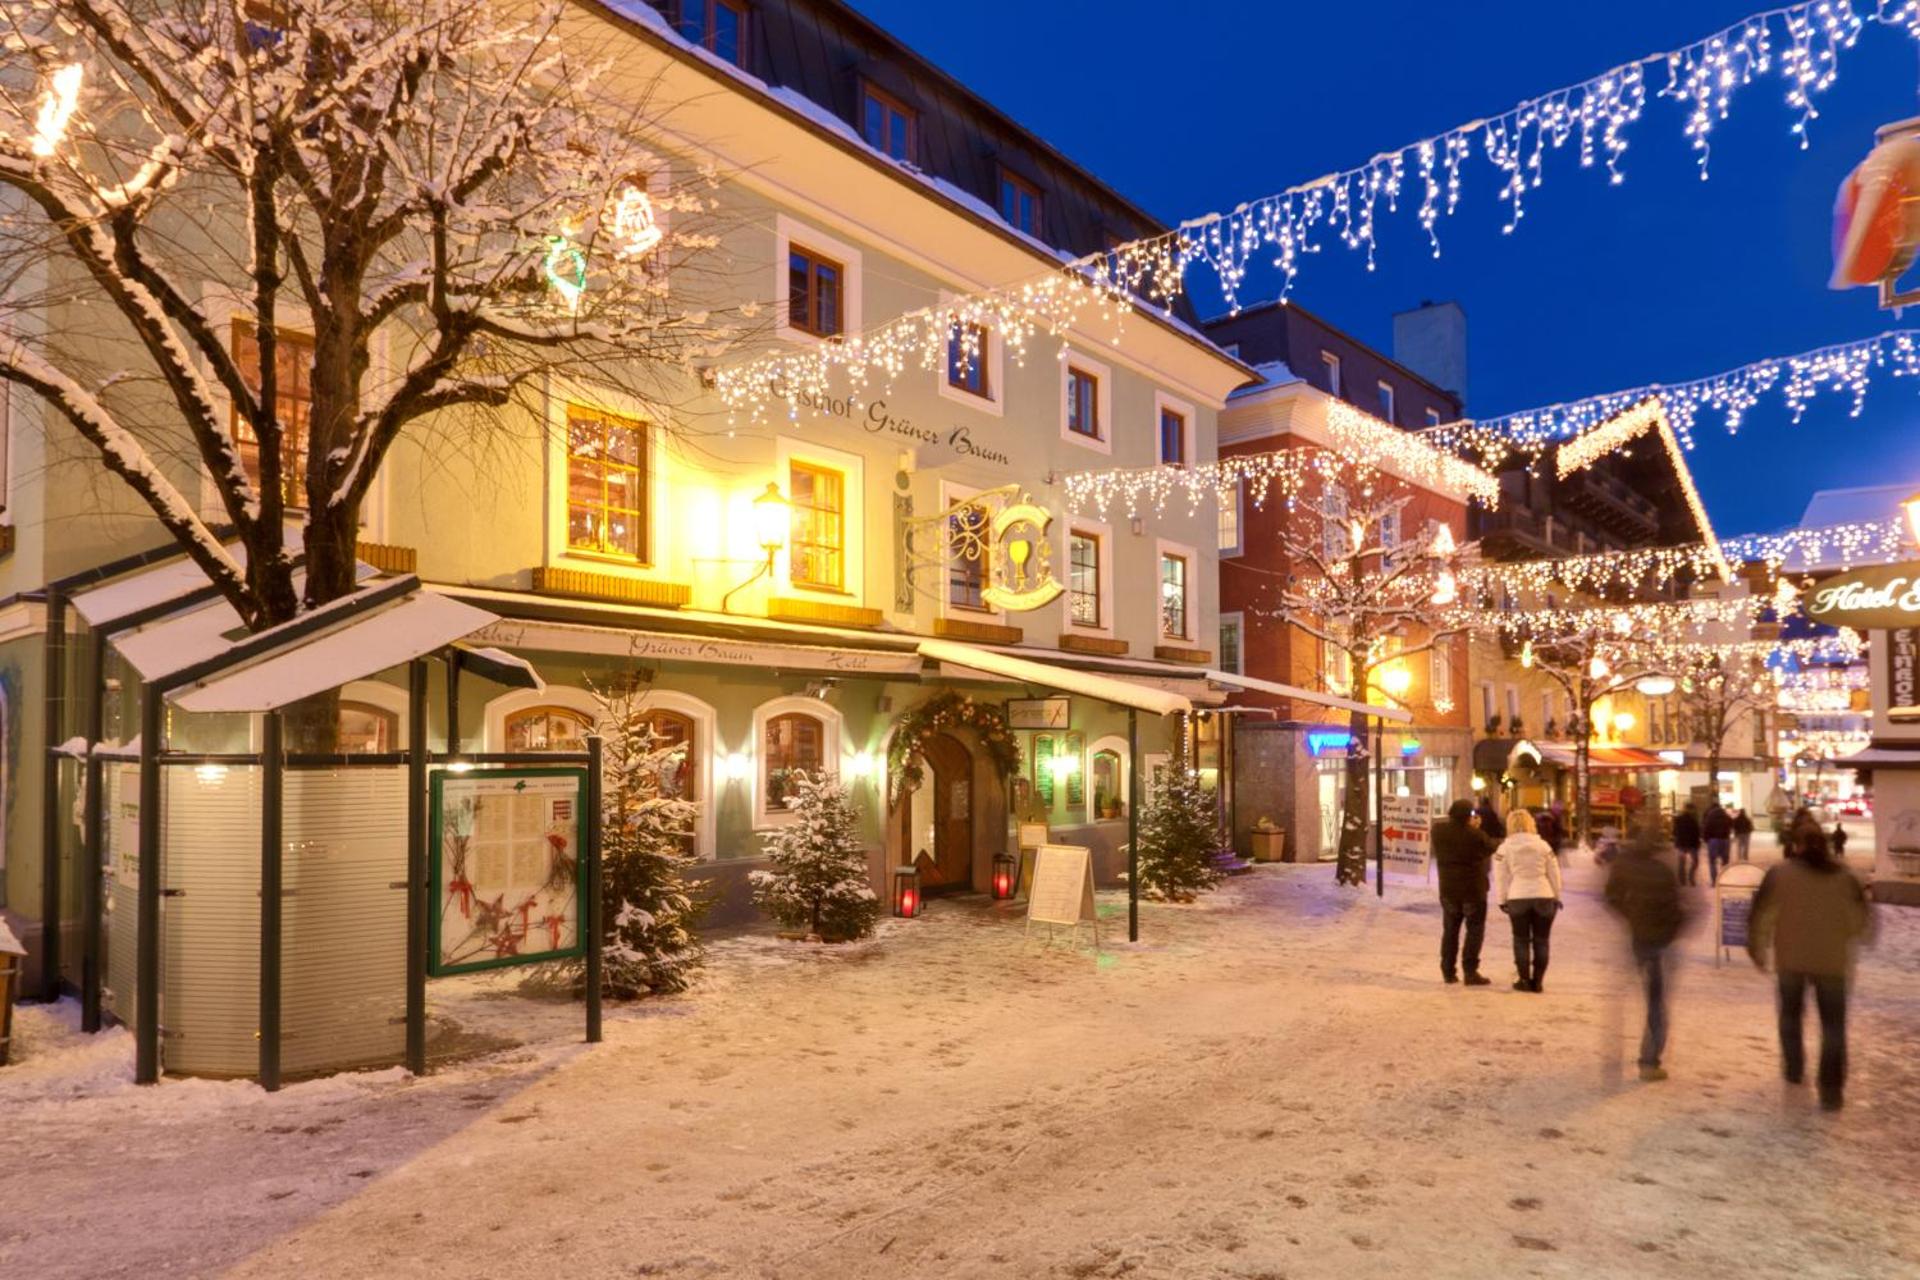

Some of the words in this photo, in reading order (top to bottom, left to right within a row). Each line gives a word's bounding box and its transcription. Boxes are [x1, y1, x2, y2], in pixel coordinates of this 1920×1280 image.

[863, 400, 939, 444] Grüner
[949, 425, 1008, 465] Baum
[1809, 577, 1907, 614] Hotel
